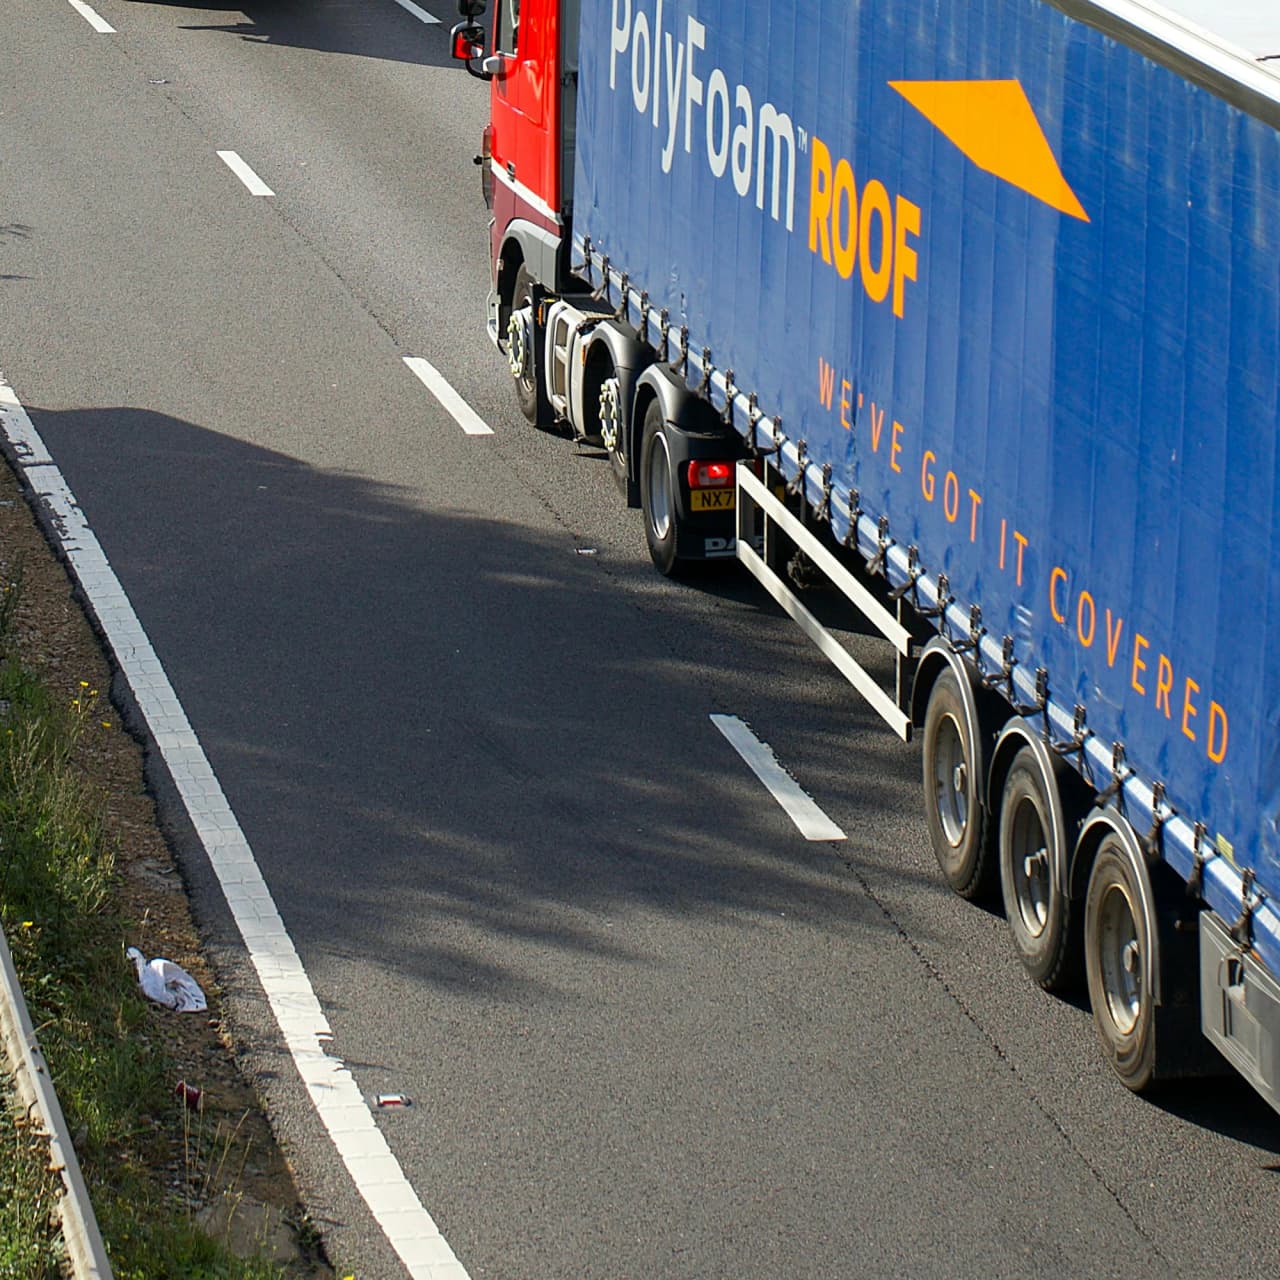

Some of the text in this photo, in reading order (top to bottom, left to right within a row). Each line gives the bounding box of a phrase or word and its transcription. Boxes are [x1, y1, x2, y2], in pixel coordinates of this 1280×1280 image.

[808, 135, 921, 320] ROOF
[702, 491, 734, 507] NX7
[818, 356, 1229, 764] WE'VE GOT IT COVERED
